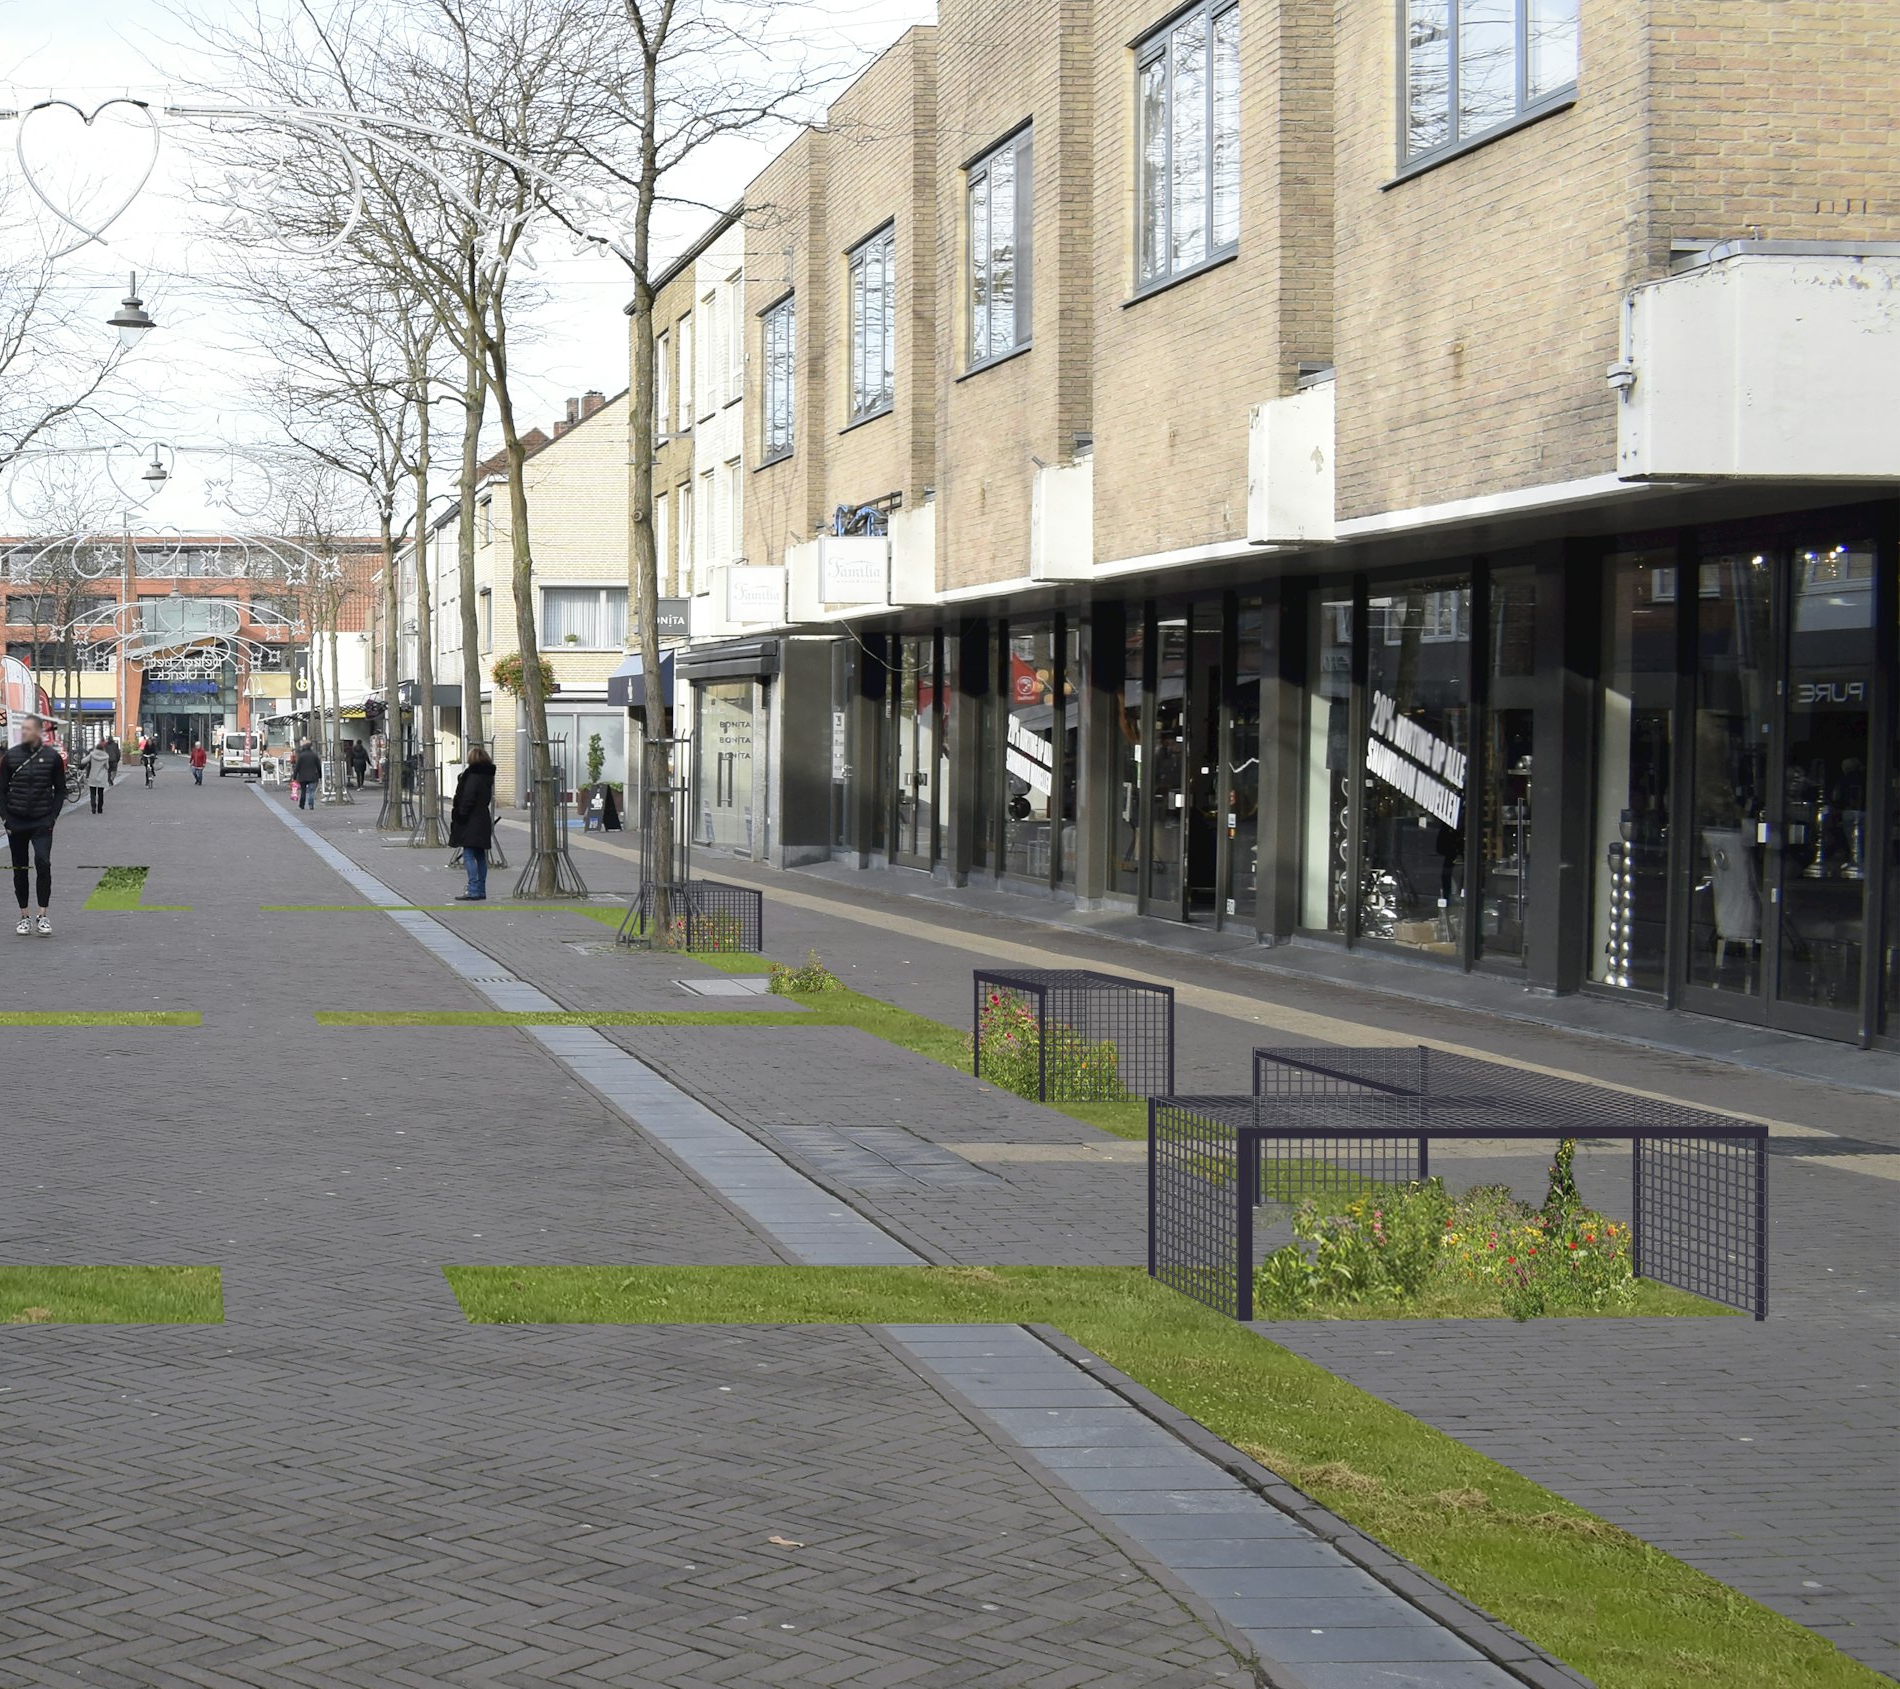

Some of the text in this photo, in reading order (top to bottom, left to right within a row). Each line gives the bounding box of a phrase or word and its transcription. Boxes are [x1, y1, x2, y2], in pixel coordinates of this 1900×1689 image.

[720, 721, 751, 729] BONITA
[720, 736, 751, 744] BONITA
[1370, 690, 1467, 789] 20% KORTING OP ALLE
[1366, 737, 1461, 830] SHOWROOM MODELLEN
